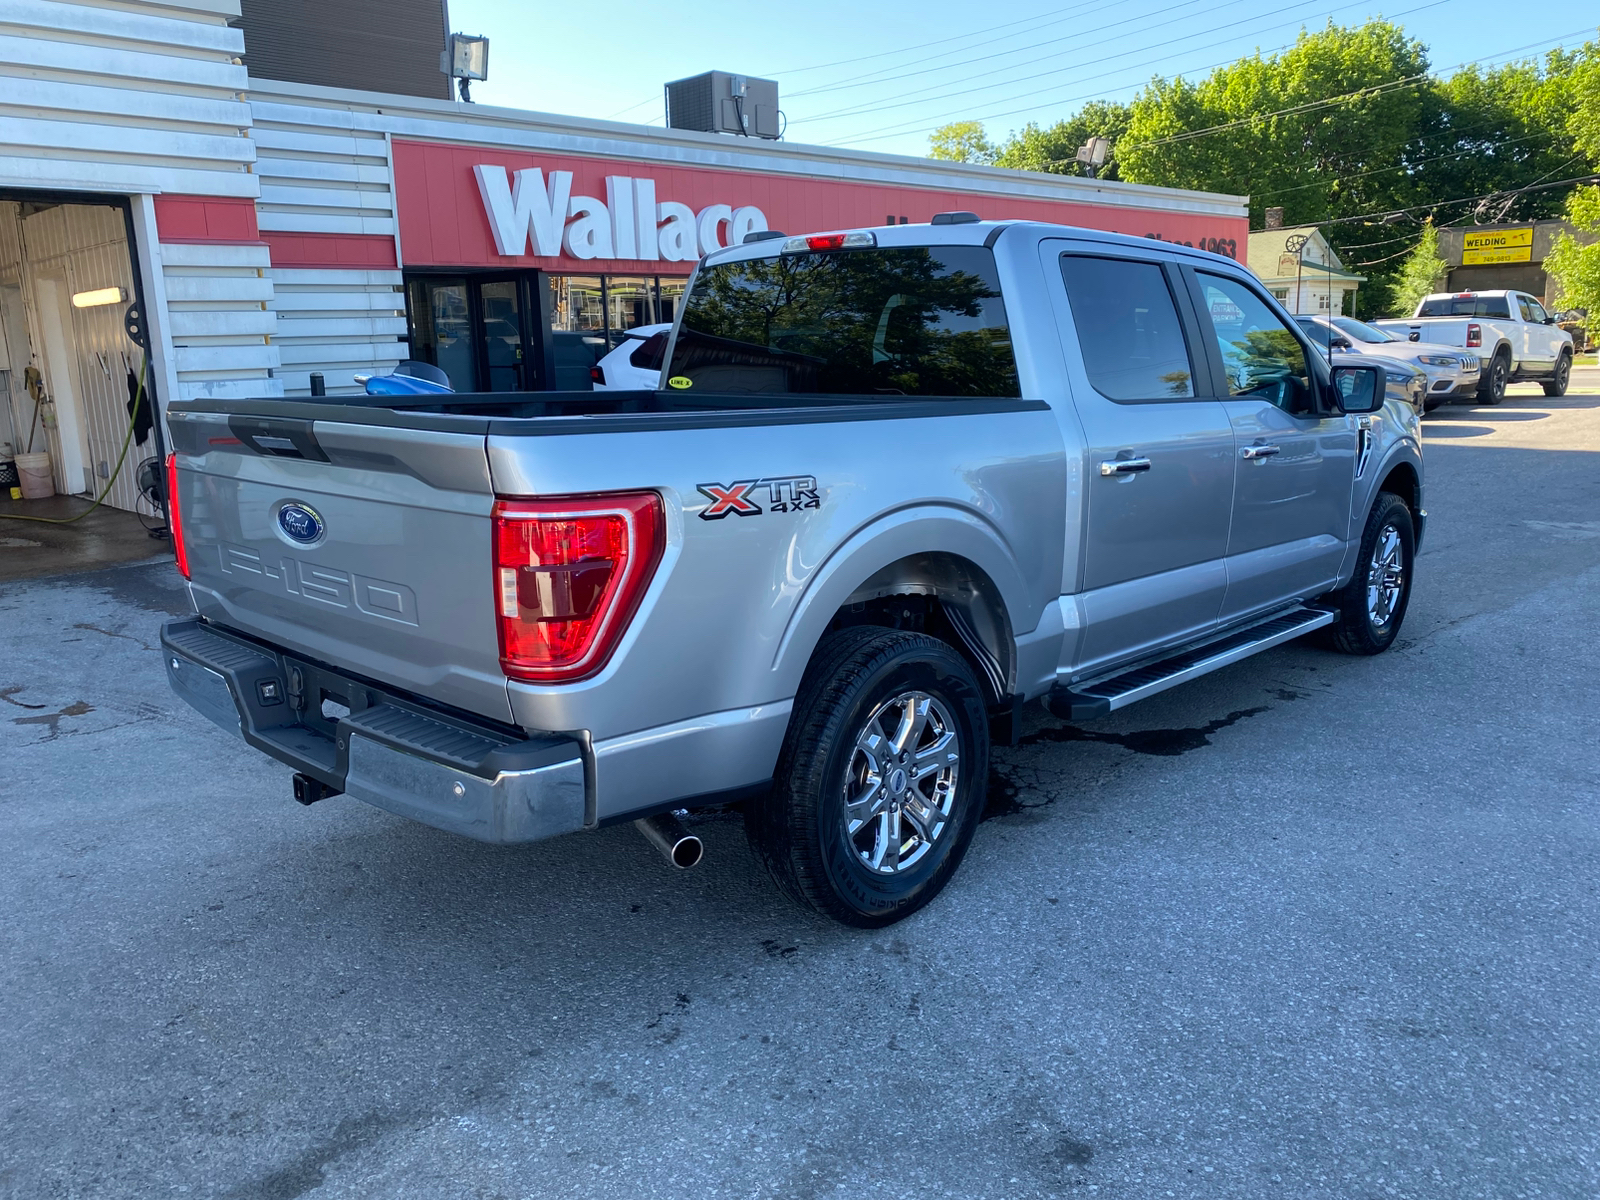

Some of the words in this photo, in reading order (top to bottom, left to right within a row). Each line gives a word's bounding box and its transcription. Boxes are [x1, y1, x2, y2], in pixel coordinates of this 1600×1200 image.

[473, 164, 768, 261] Wallace
[1199, 238, 1237, 260] 1963
[1466, 238, 1506, 247] WELDING
[696, 474, 821, 521] XTR
[770, 499, 821, 513] 4x4
[284, 510, 310, 536] Ford
[217, 540, 420, 627] F-150
